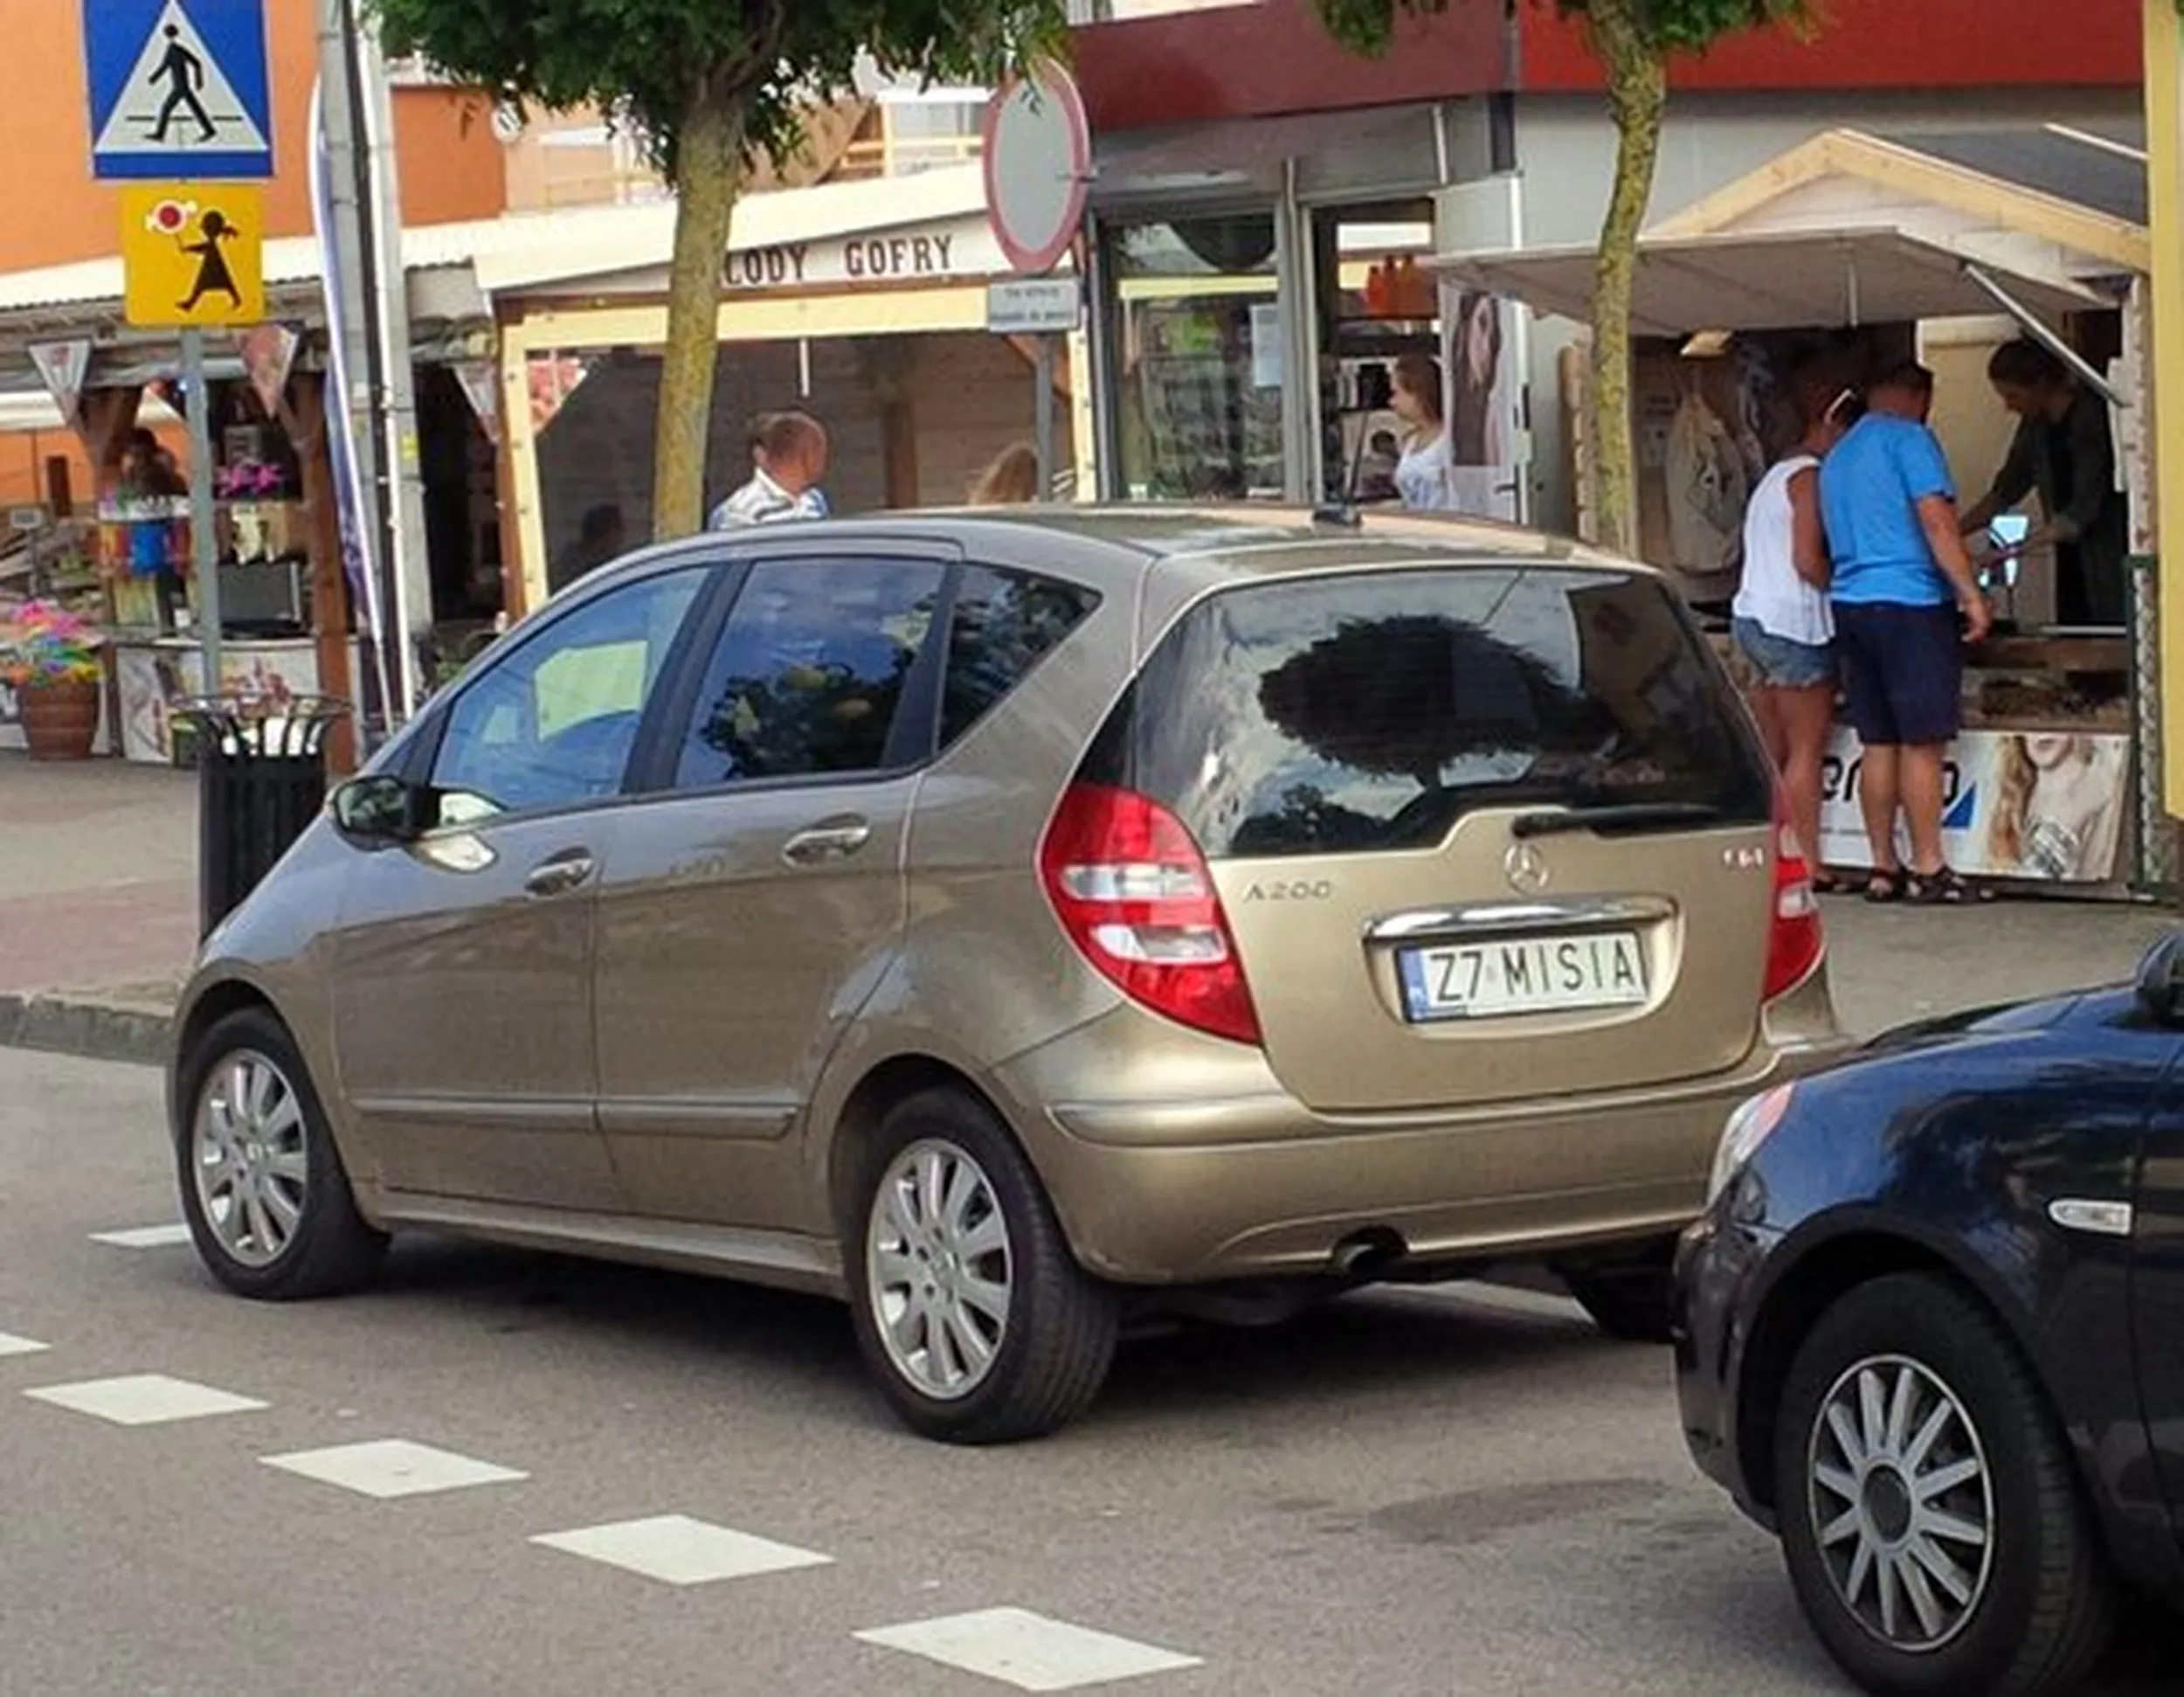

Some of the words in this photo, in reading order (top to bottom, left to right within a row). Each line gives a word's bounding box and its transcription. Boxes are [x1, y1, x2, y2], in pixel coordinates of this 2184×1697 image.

[724, 243, 807, 285] LODY
[844, 234, 952, 276] GOFRY
[1242, 881, 1330, 903] A200
[1430, 951, 1482, 1001] Z7
[1502, 939, 1635, 995] MISIA
